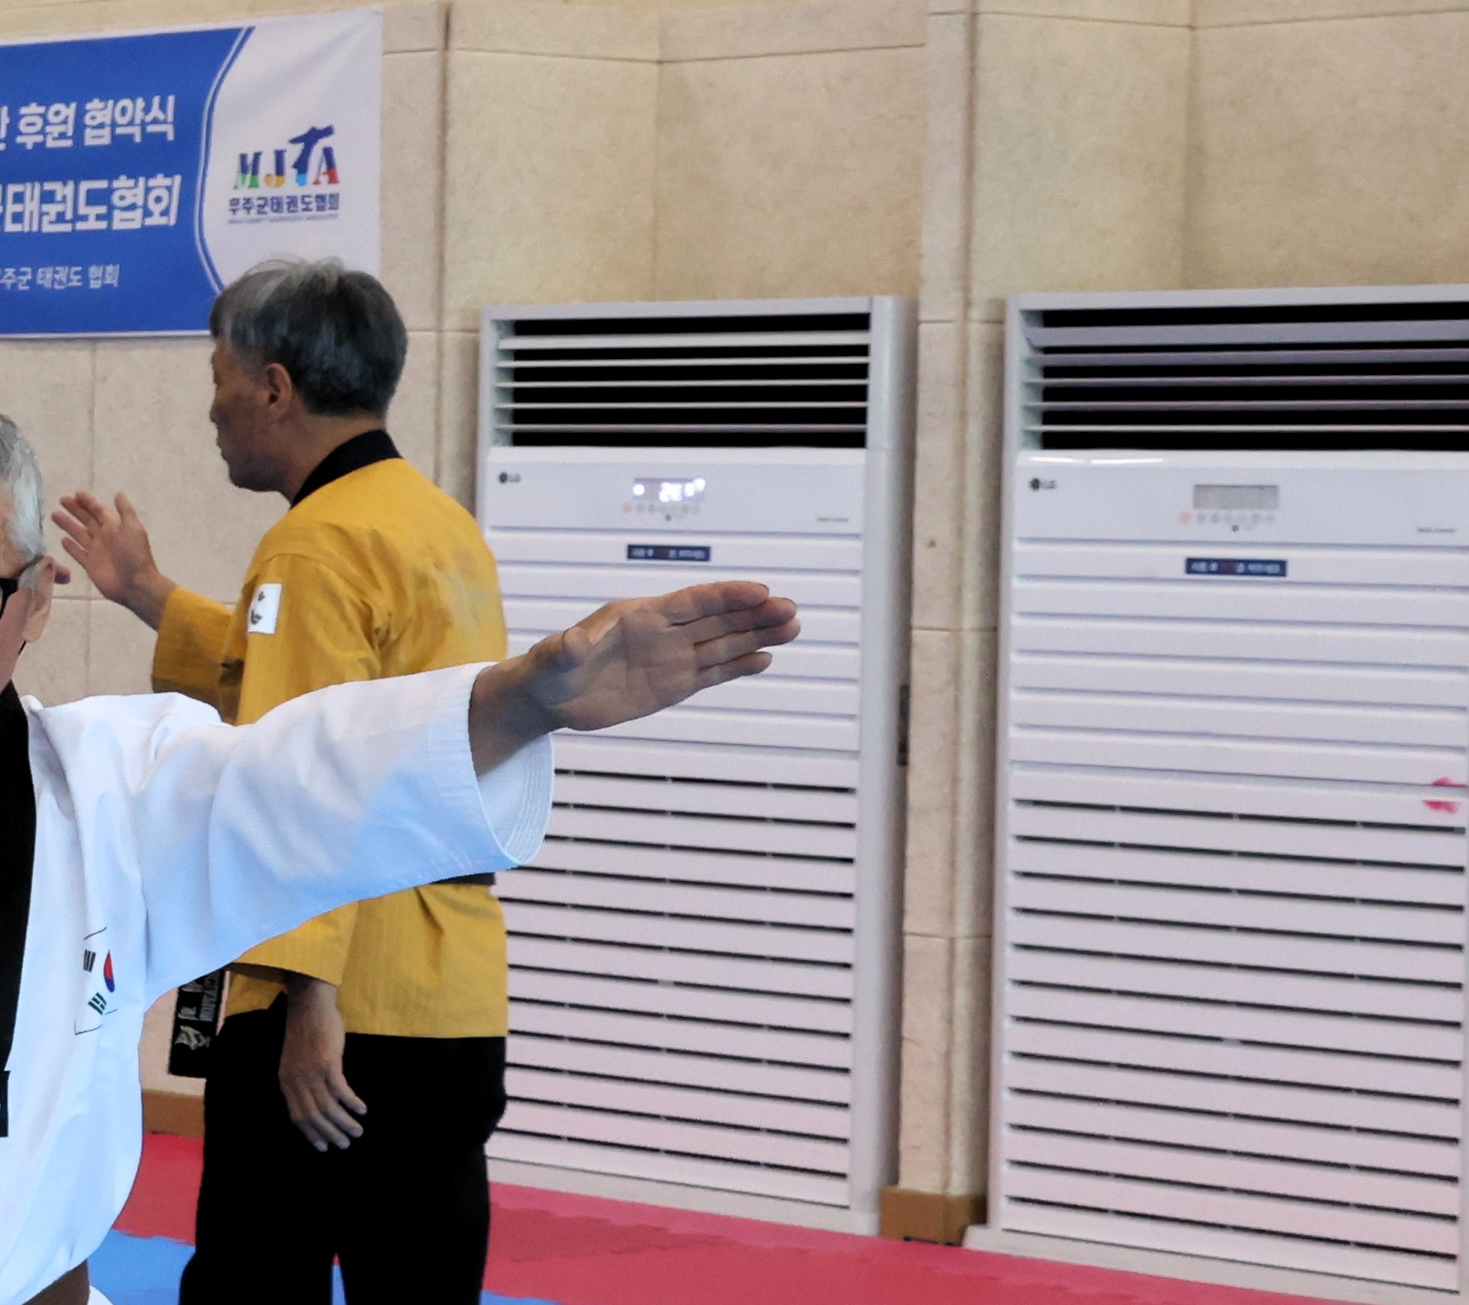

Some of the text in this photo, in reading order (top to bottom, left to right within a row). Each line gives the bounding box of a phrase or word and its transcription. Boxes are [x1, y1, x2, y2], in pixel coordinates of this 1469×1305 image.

[14, 101, 77, 150] 후원
[82, 94, 177, 145] 협약식
[37, 265, 83, 290] 태권도
[88, 263, 120, 289] 협회
